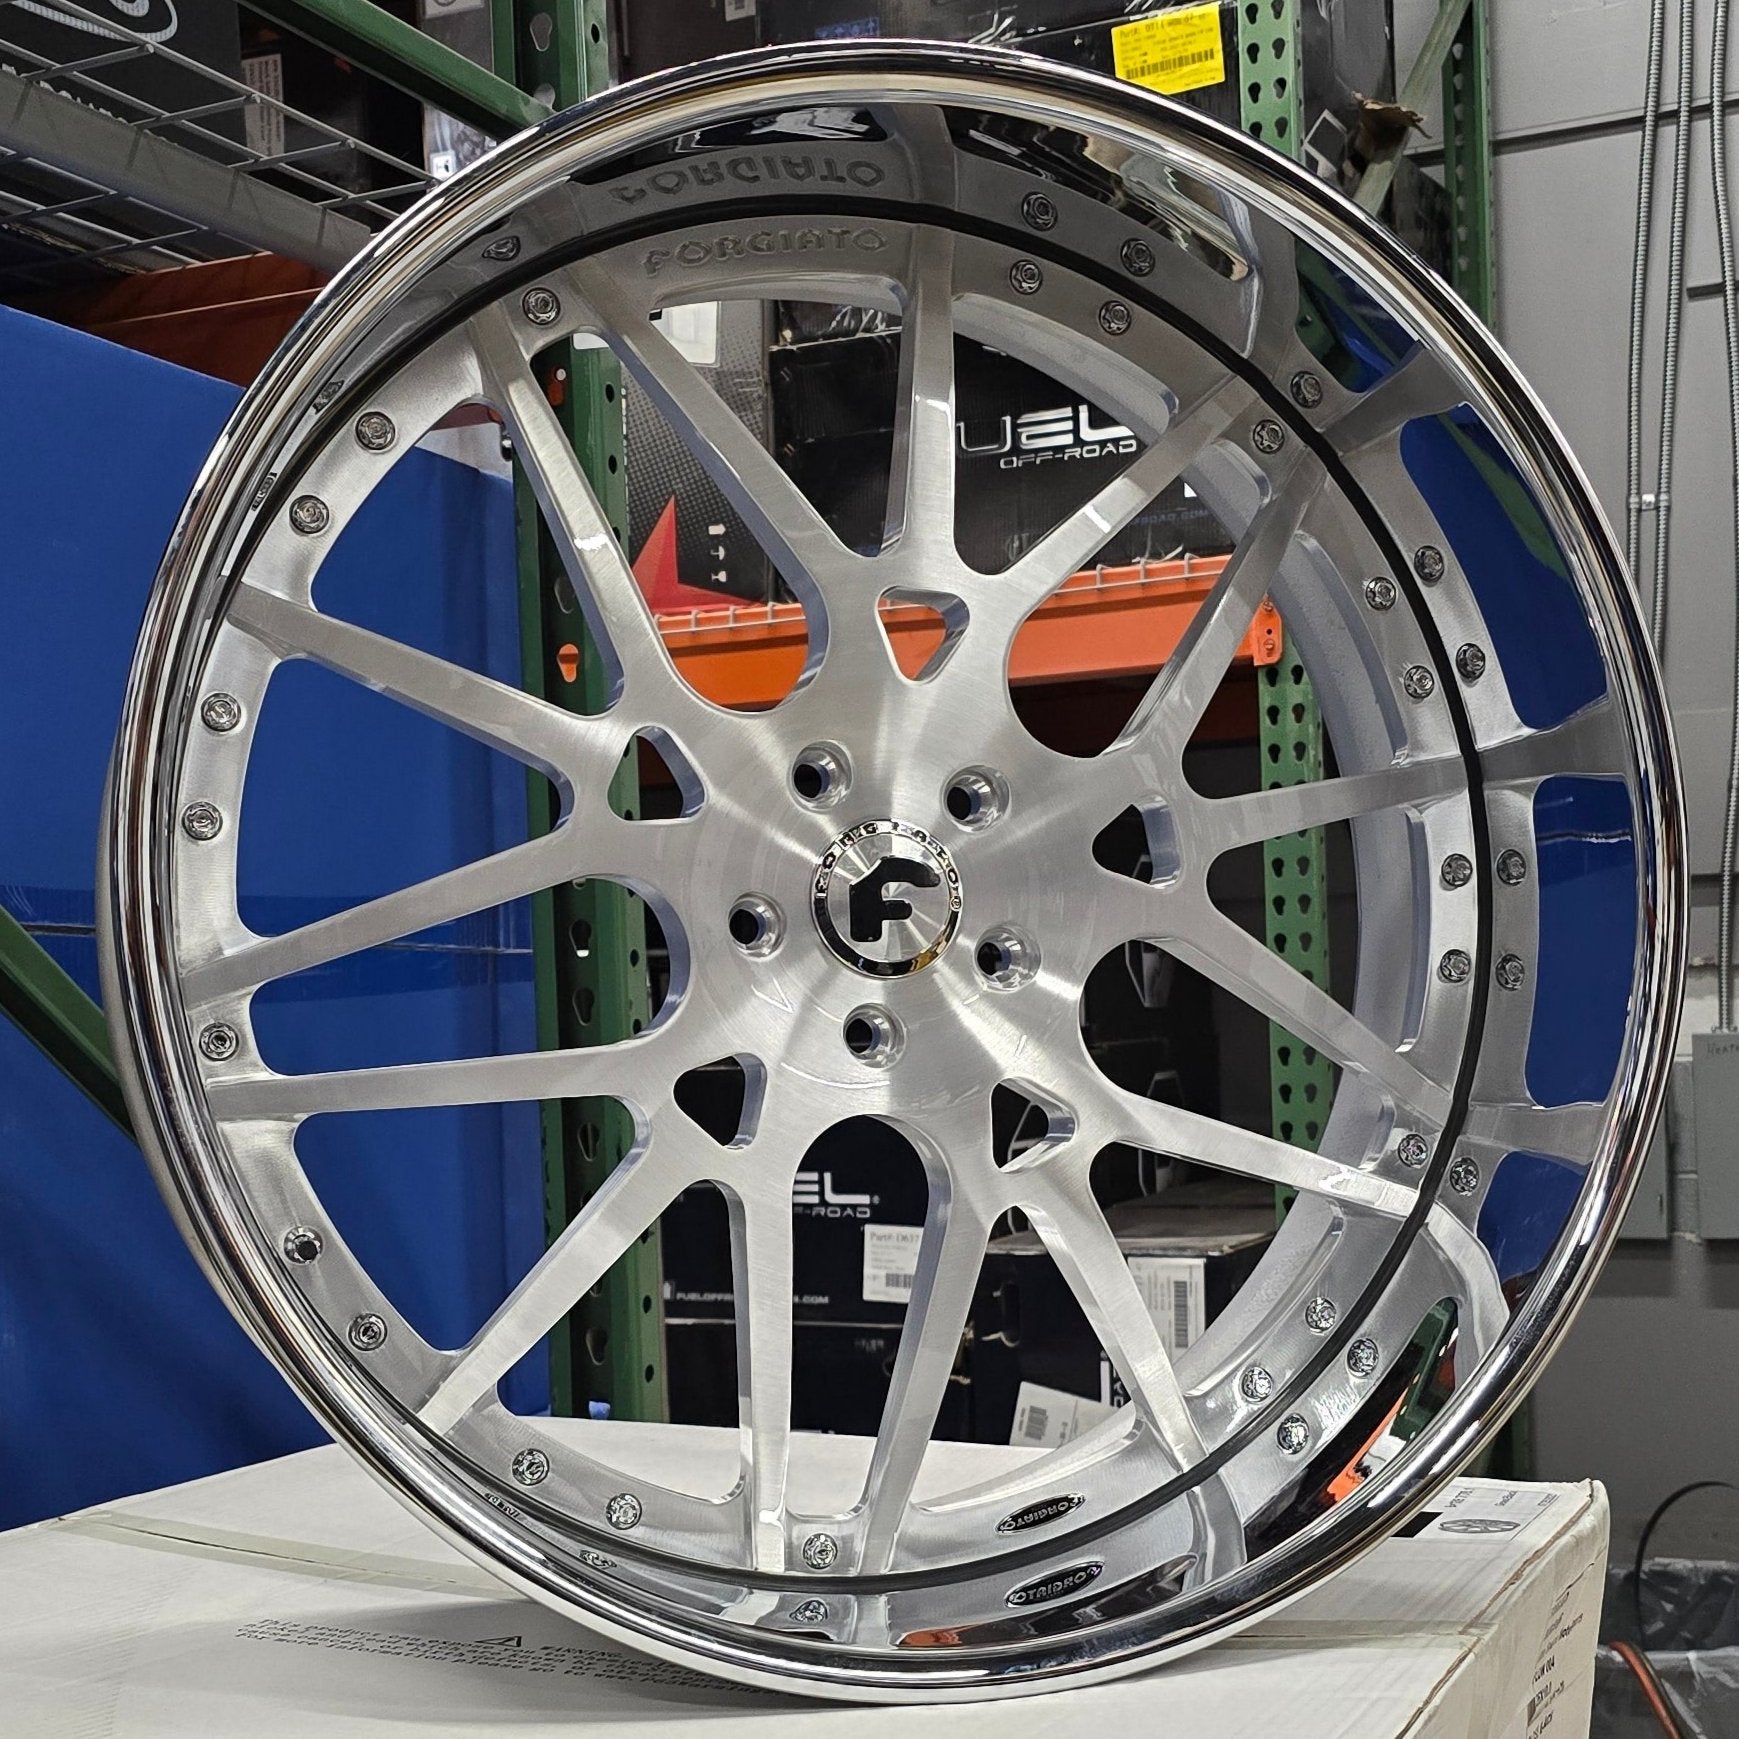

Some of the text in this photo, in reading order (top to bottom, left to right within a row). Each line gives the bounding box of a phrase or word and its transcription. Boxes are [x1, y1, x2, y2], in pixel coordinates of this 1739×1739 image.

[641, 228, 886, 277] FORGIATO
[956, 404, 1135, 455] UEL
[1000, 439, 1137, 469] OFF-ROAD
[849, 856, 941, 942] F
[792, 1171, 871, 1205] EL
